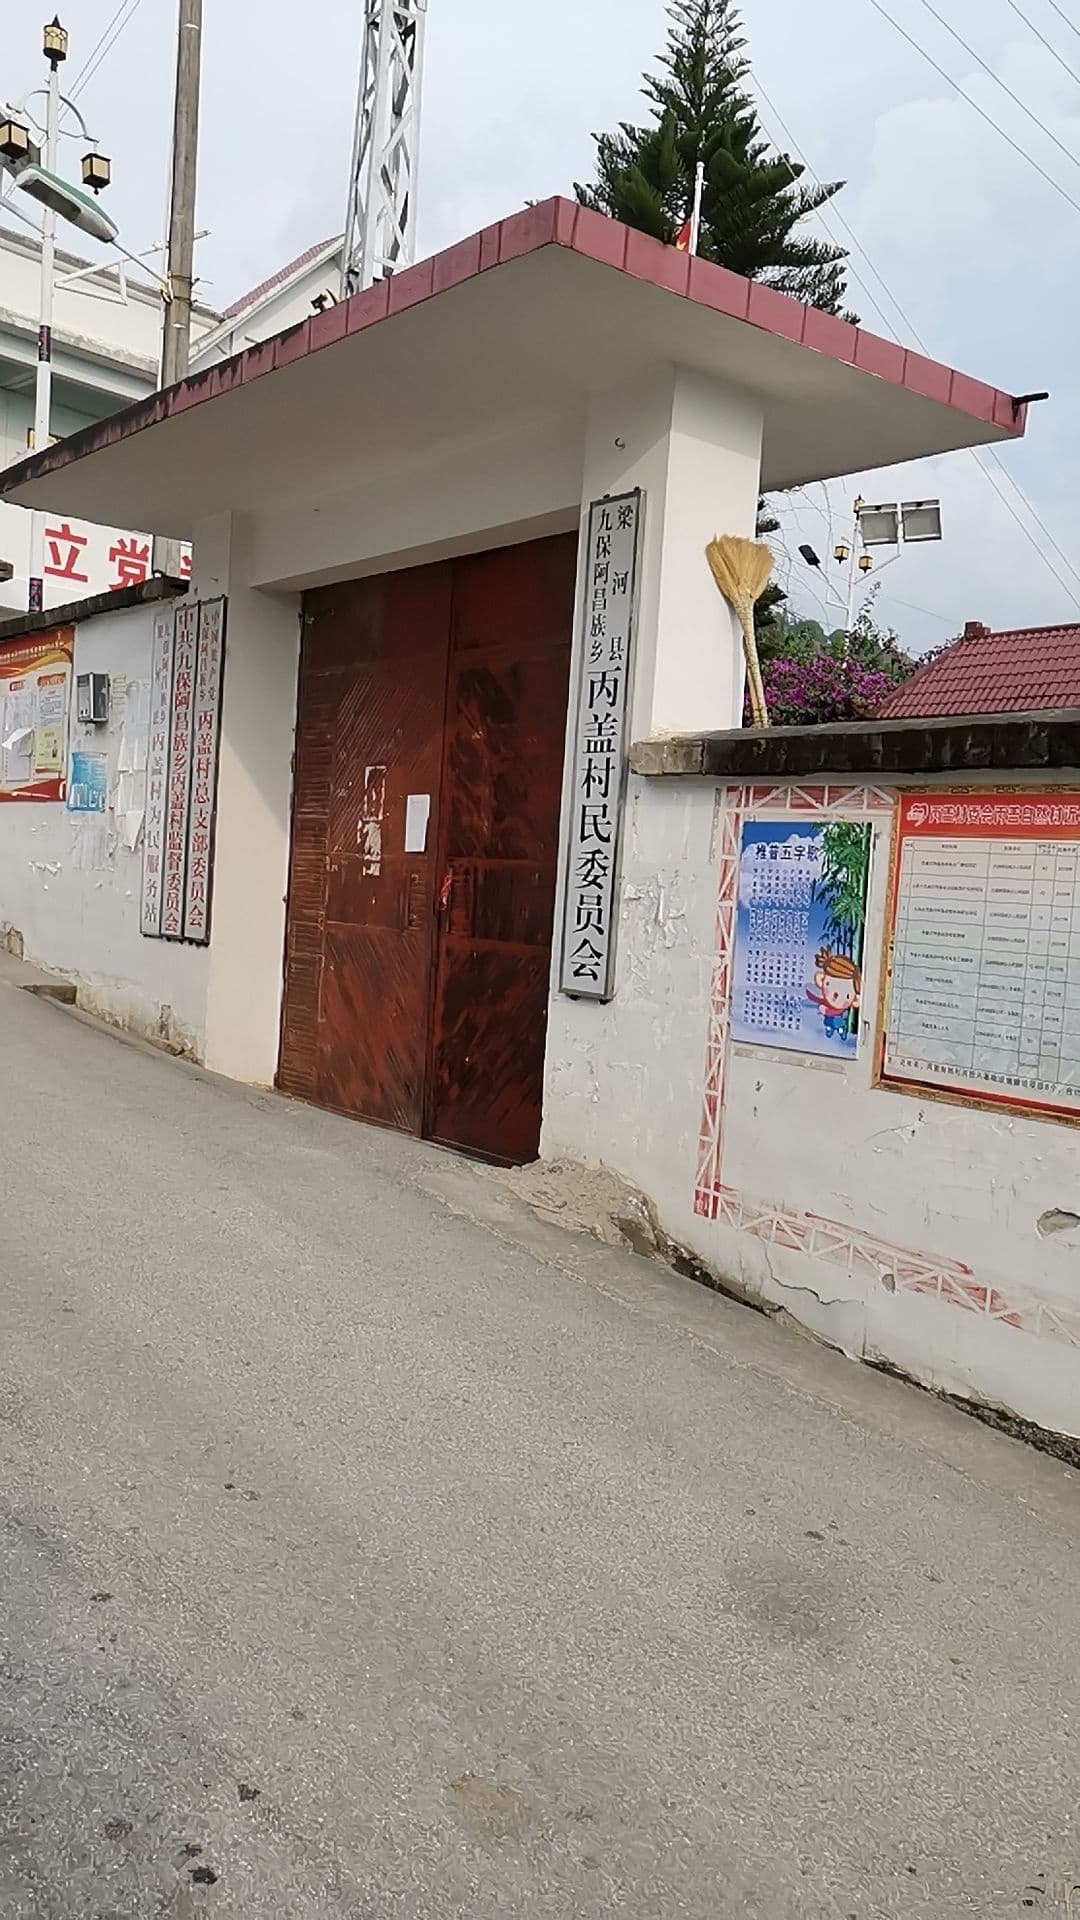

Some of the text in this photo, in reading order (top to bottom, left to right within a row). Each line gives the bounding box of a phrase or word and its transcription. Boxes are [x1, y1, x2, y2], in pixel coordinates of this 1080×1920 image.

[44, 524, 192, 591] 立党
[588, 508, 613, 665] 九保阿昌族乡
[608, 504, 634, 661] 梁河县
[188, 708, 215, 928] 丙盖村总支部委员会
[570, 665, 622, 983] 丙盖村民委员会
